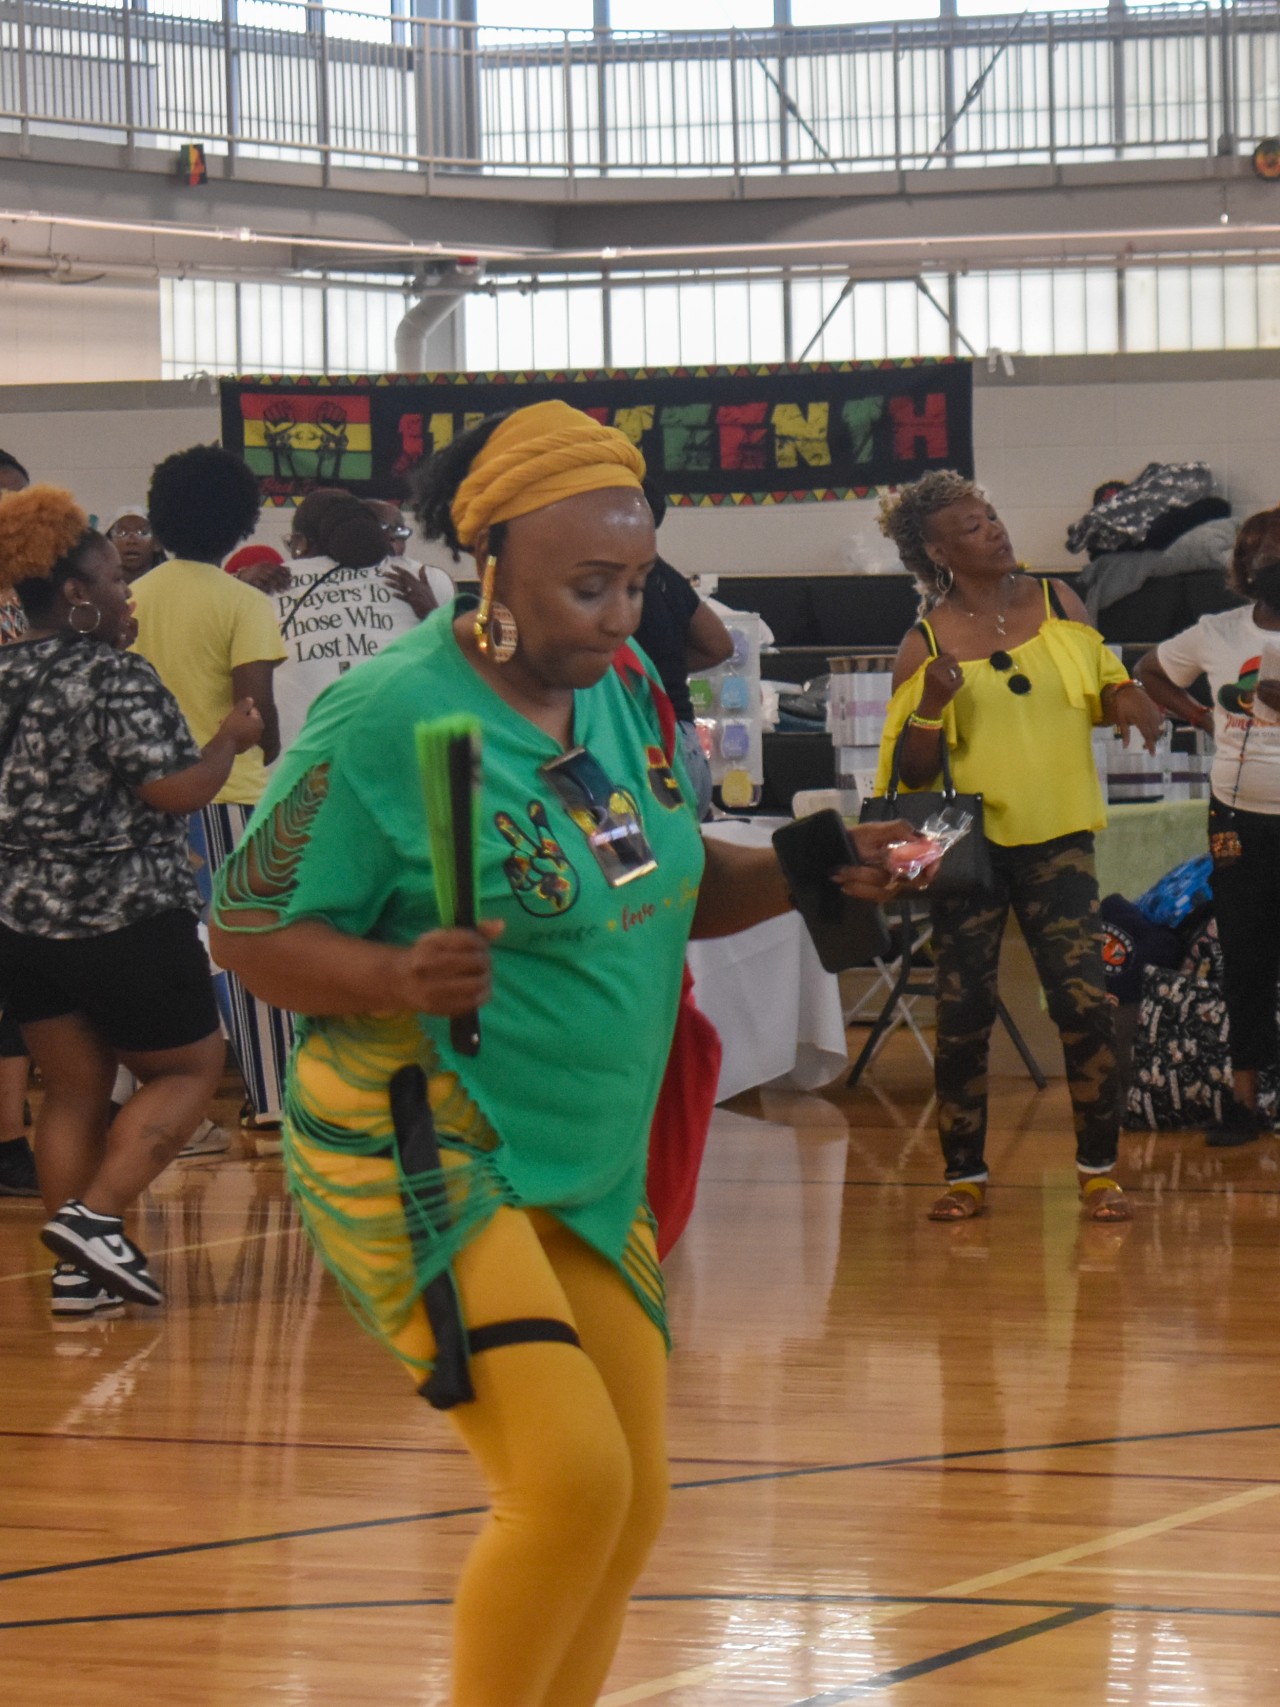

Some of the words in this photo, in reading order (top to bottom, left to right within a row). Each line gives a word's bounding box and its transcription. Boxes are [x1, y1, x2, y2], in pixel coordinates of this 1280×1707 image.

[392, 393, 949, 478] JTEENTH
[344, 605, 394, 631] Who
[296, 637, 342, 663] Lost
[345, 633, 378, 657] Me
